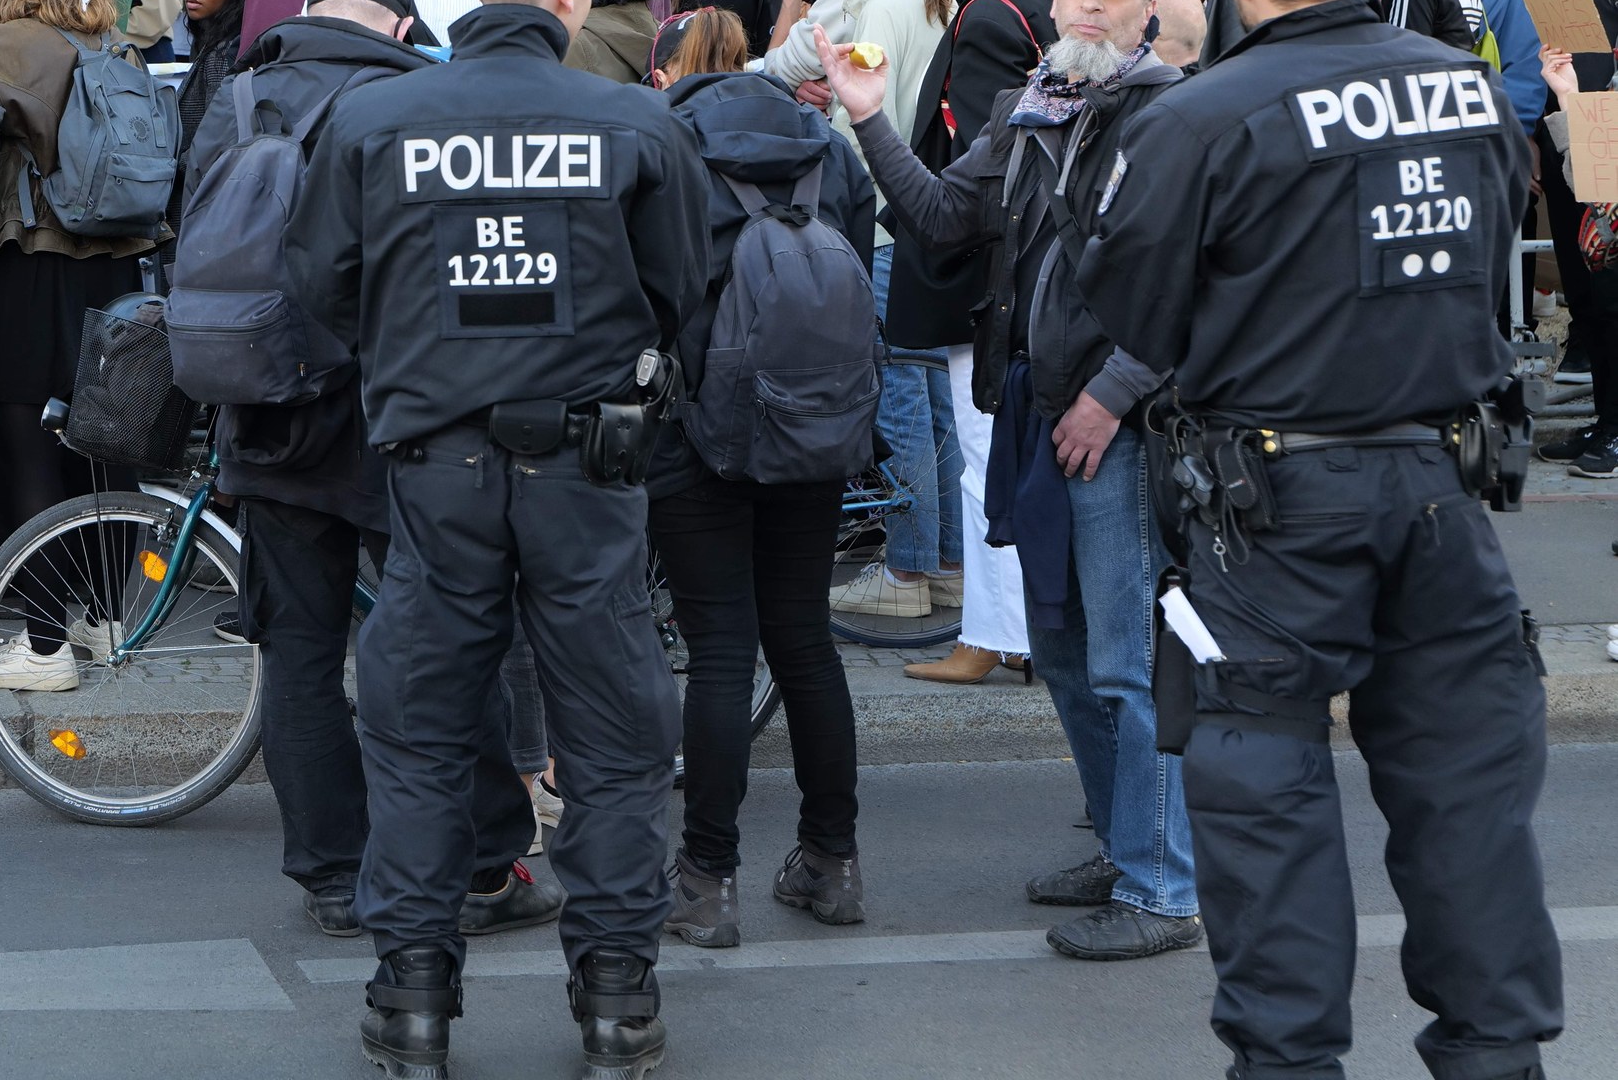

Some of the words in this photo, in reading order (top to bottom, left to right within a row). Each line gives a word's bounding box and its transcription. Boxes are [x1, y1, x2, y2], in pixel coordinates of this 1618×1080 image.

[1296, 69, 1500, 149] POLIZEI
[1576, 97, 1612, 123] WE
[403, 134, 601, 192] POLIZEI
[1398, 156, 1445, 196] BE
[476, 215, 525, 248] BE
[1371, 195, 1472, 240] 12120
[447, 252, 558, 286] 12129
